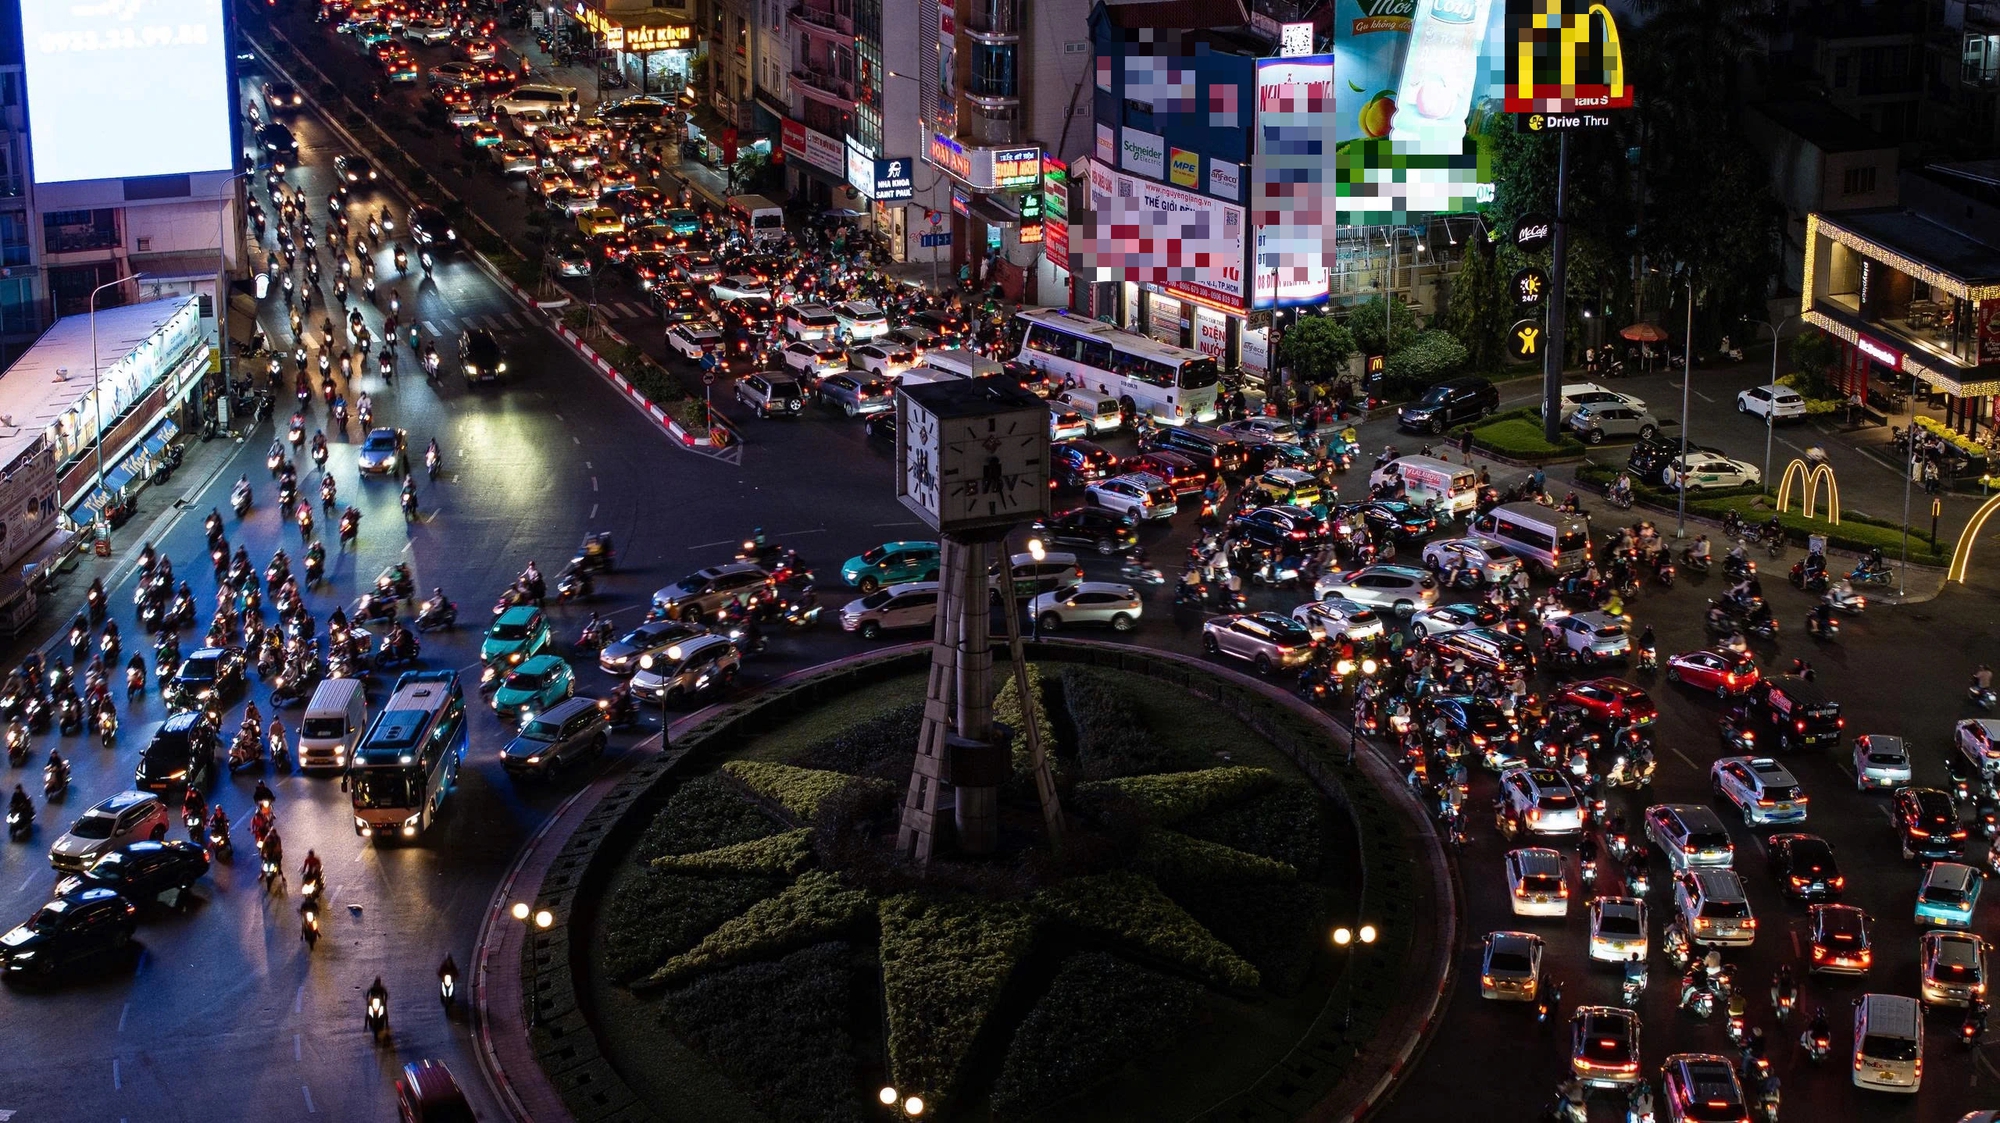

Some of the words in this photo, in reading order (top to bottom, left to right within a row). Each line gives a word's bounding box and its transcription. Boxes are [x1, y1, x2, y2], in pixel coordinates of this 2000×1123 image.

[1370, 19, 1396, 31] không
[656, 25, 690, 41] KÍNH
[1547, 116, 1580, 128] Drive
[1583, 115, 1609, 126] Thru
[1124, 140, 1162, 160] Schneider
[1139, 155, 1162, 167] Electric
[1173, 160, 1196, 173] MPE
[892, 178, 910, 188] KHOA
[876, 190, 895, 199] SAINT
[896, 189, 912, 198] PAUL
[1145, 194, 1160, 208] THẾ
[1518, 225, 1548, 240] McCafé
[1257, 274, 1265, 289] 08
[1522, 294, 1538, 303] 24/7
[1249, 313, 1260, 324] Số
[1261, 311, 1271, 322] 08
[1202, 324, 1226, 343] ĐIỆN
[40, 492, 55, 521] 7K
[1863, 1060, 1883, 1069] FedEx
